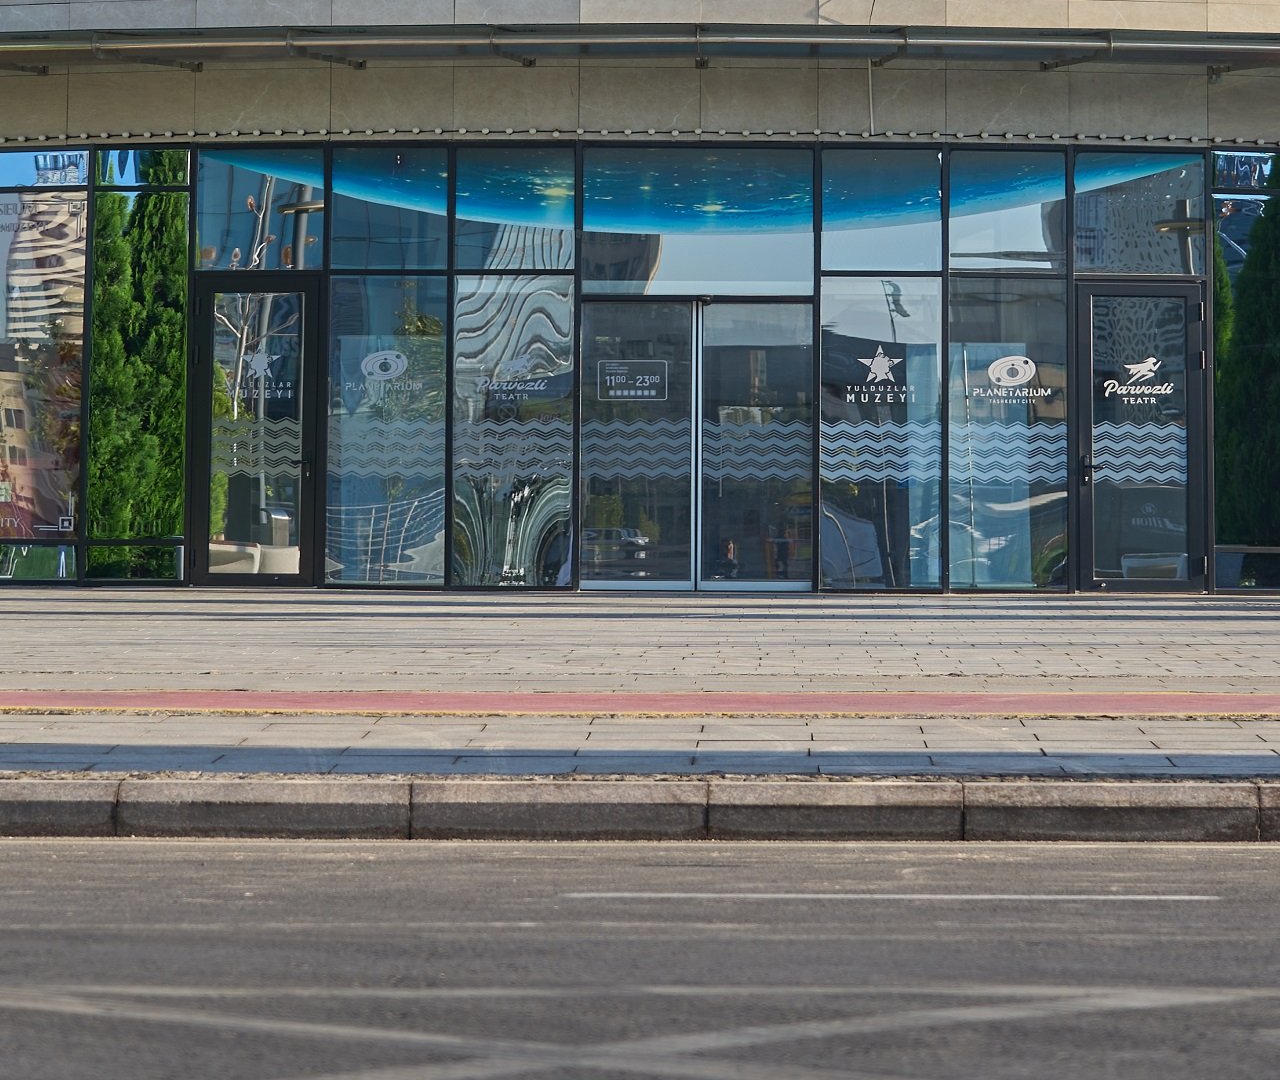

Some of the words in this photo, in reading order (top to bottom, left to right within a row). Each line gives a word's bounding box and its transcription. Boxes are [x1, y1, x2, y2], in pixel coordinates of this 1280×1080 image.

[475, 376, 548, 392] Parvozli
[1103, 379, 1174, 397] Parvozli
[846, 393, 916, 403] MUZEYI
[973, 388, 1052, 397] PLANETARIUM
